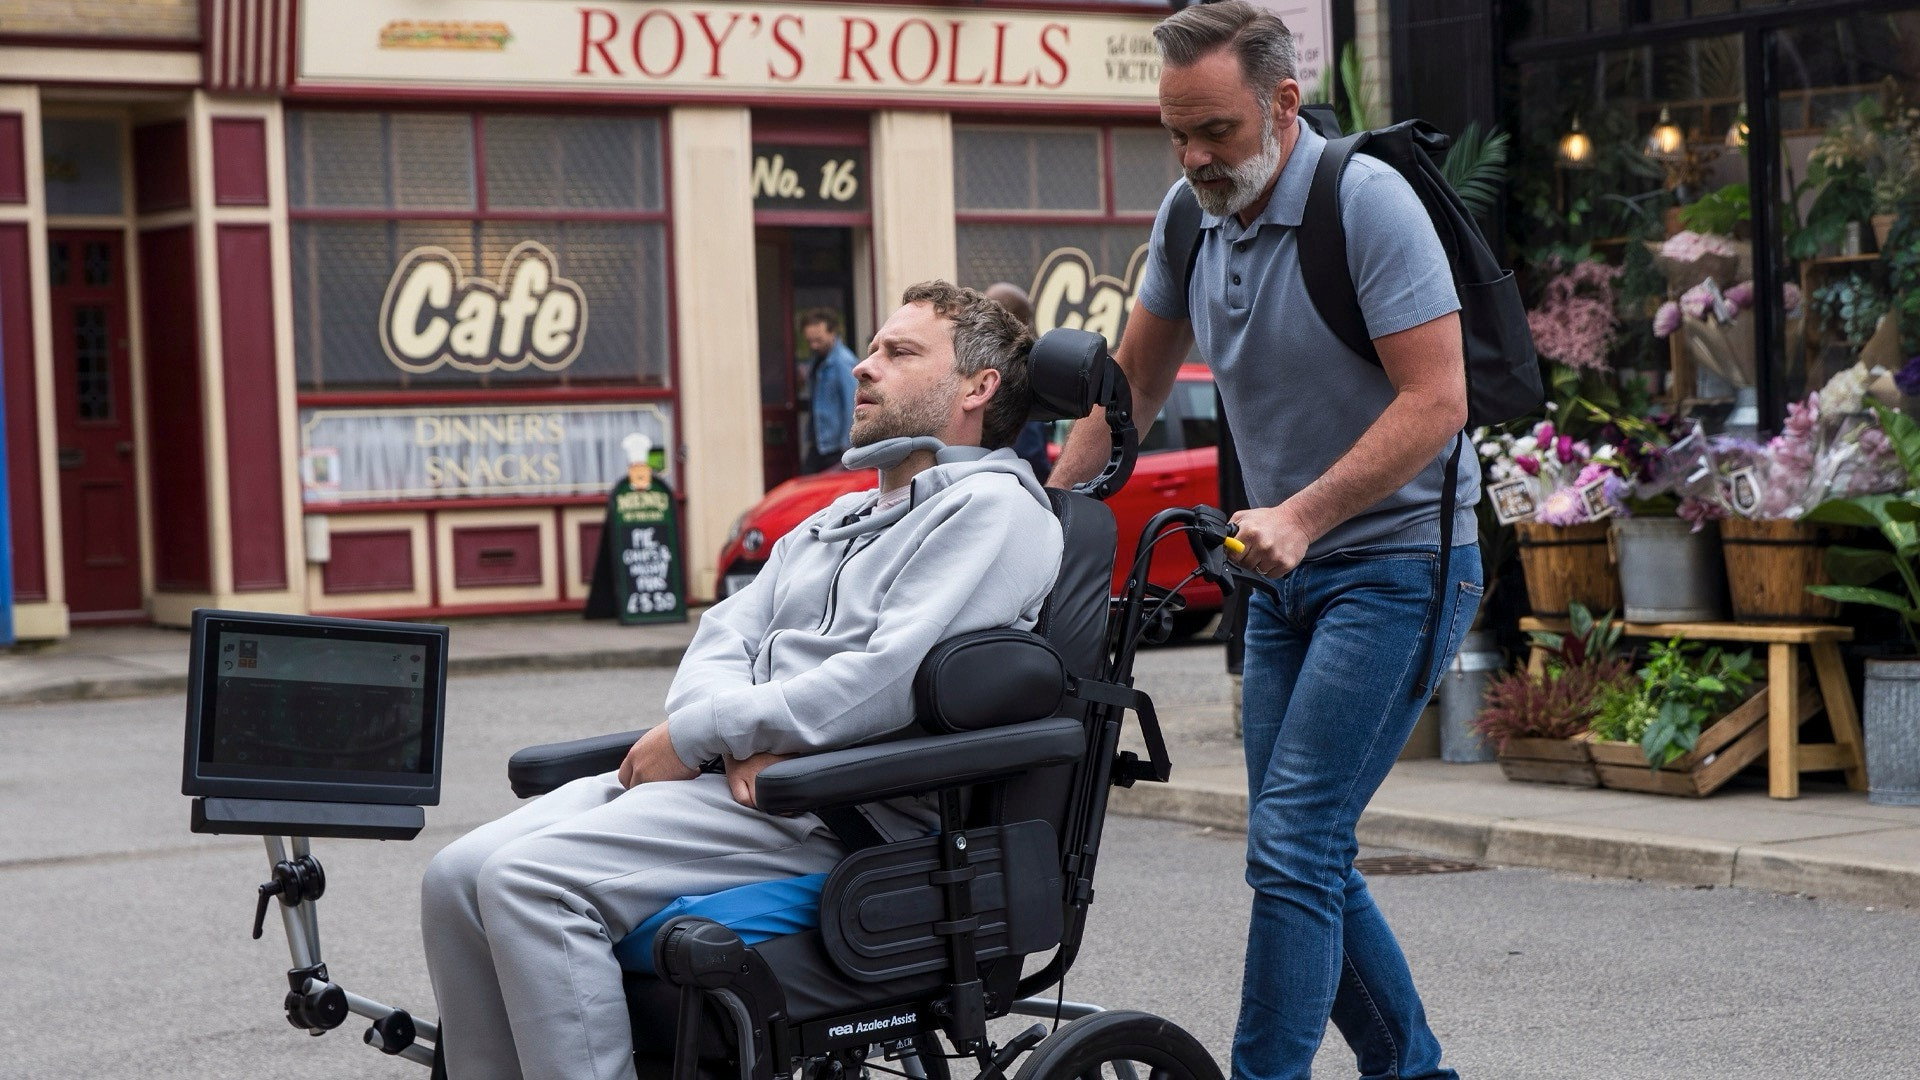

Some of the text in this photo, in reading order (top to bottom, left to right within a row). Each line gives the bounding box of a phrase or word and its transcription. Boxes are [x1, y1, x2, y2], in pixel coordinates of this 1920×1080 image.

[575, 8, 1071, 88] ROY'S ROLLS
[751, 153, 859, 202] No. 16
[390, 256, 579, 361] Cafe
[1035, 260, 1147, 349] Ca
[414, 413, 567, 446] DINNERS
[424, 453, 562, 487] SNACKS
[828, 1012, 917, 1037] rea Azalea Assist
